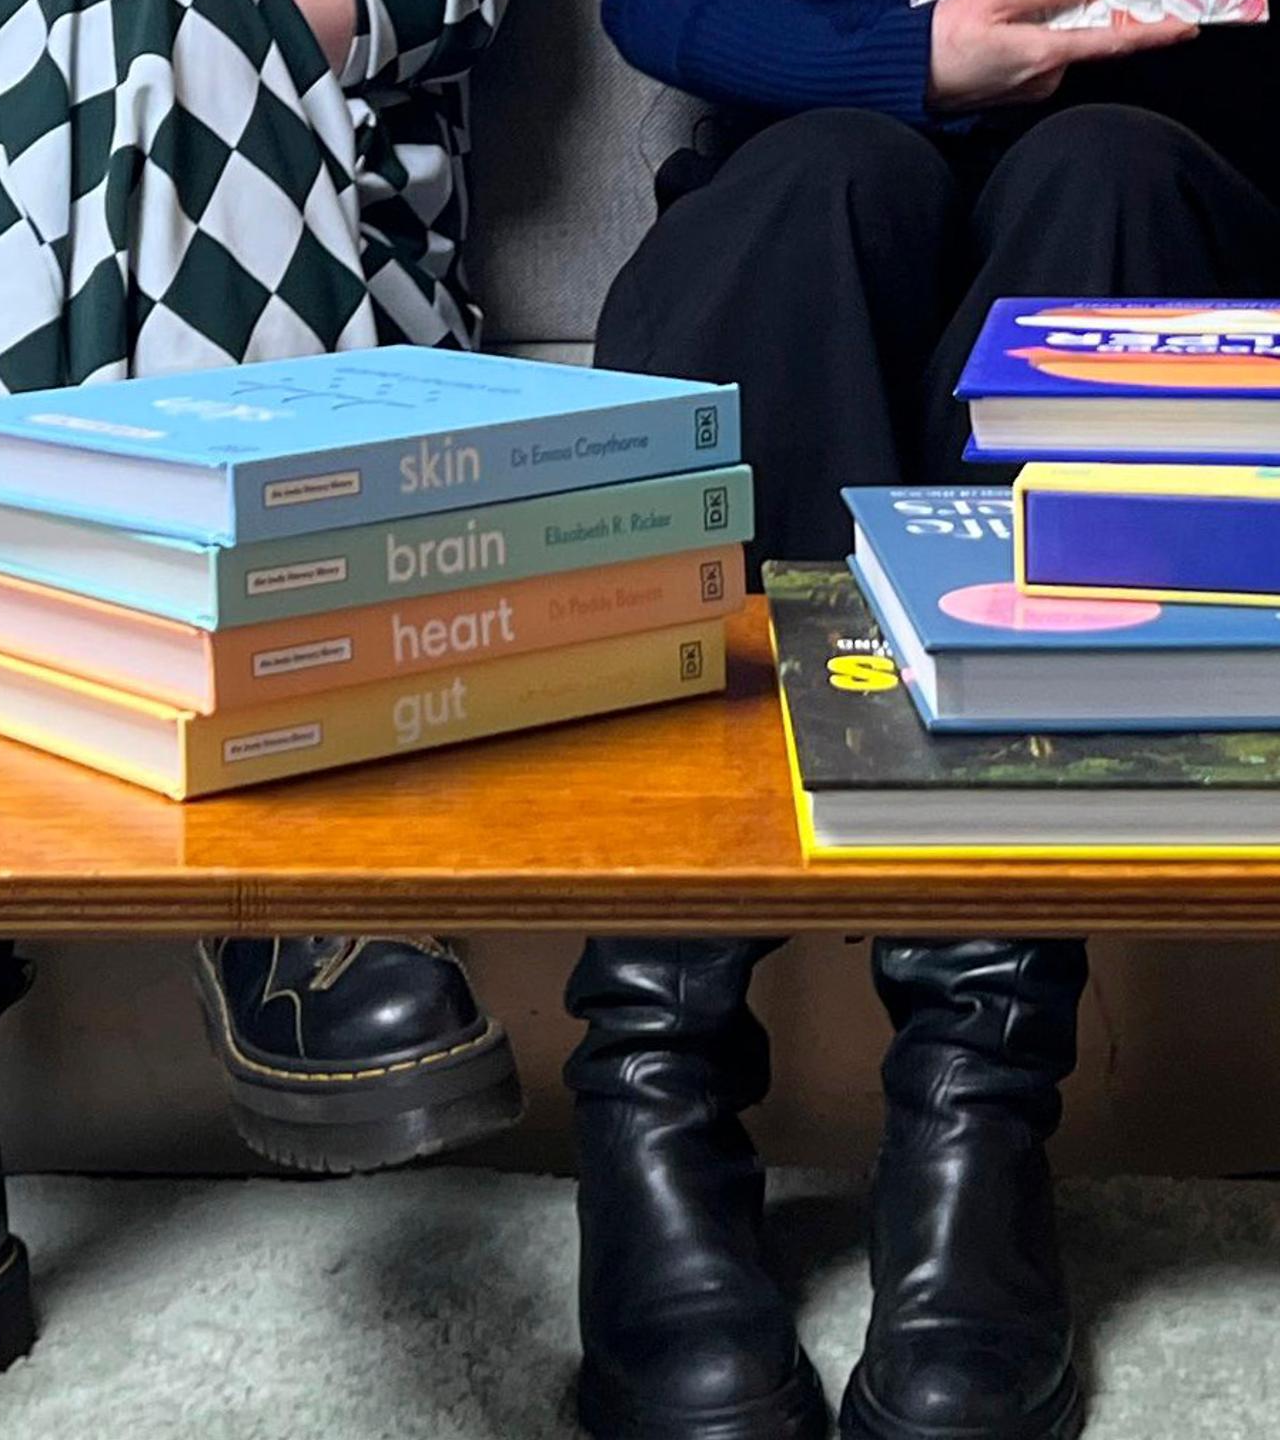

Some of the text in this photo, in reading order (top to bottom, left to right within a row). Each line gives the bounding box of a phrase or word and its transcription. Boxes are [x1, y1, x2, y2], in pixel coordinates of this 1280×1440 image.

[399, 436, 481, 494] skin
[385, 519, 506, 584] brain
[391, 597, 516, 663] heart
[392, 676, 467, 746] gut
